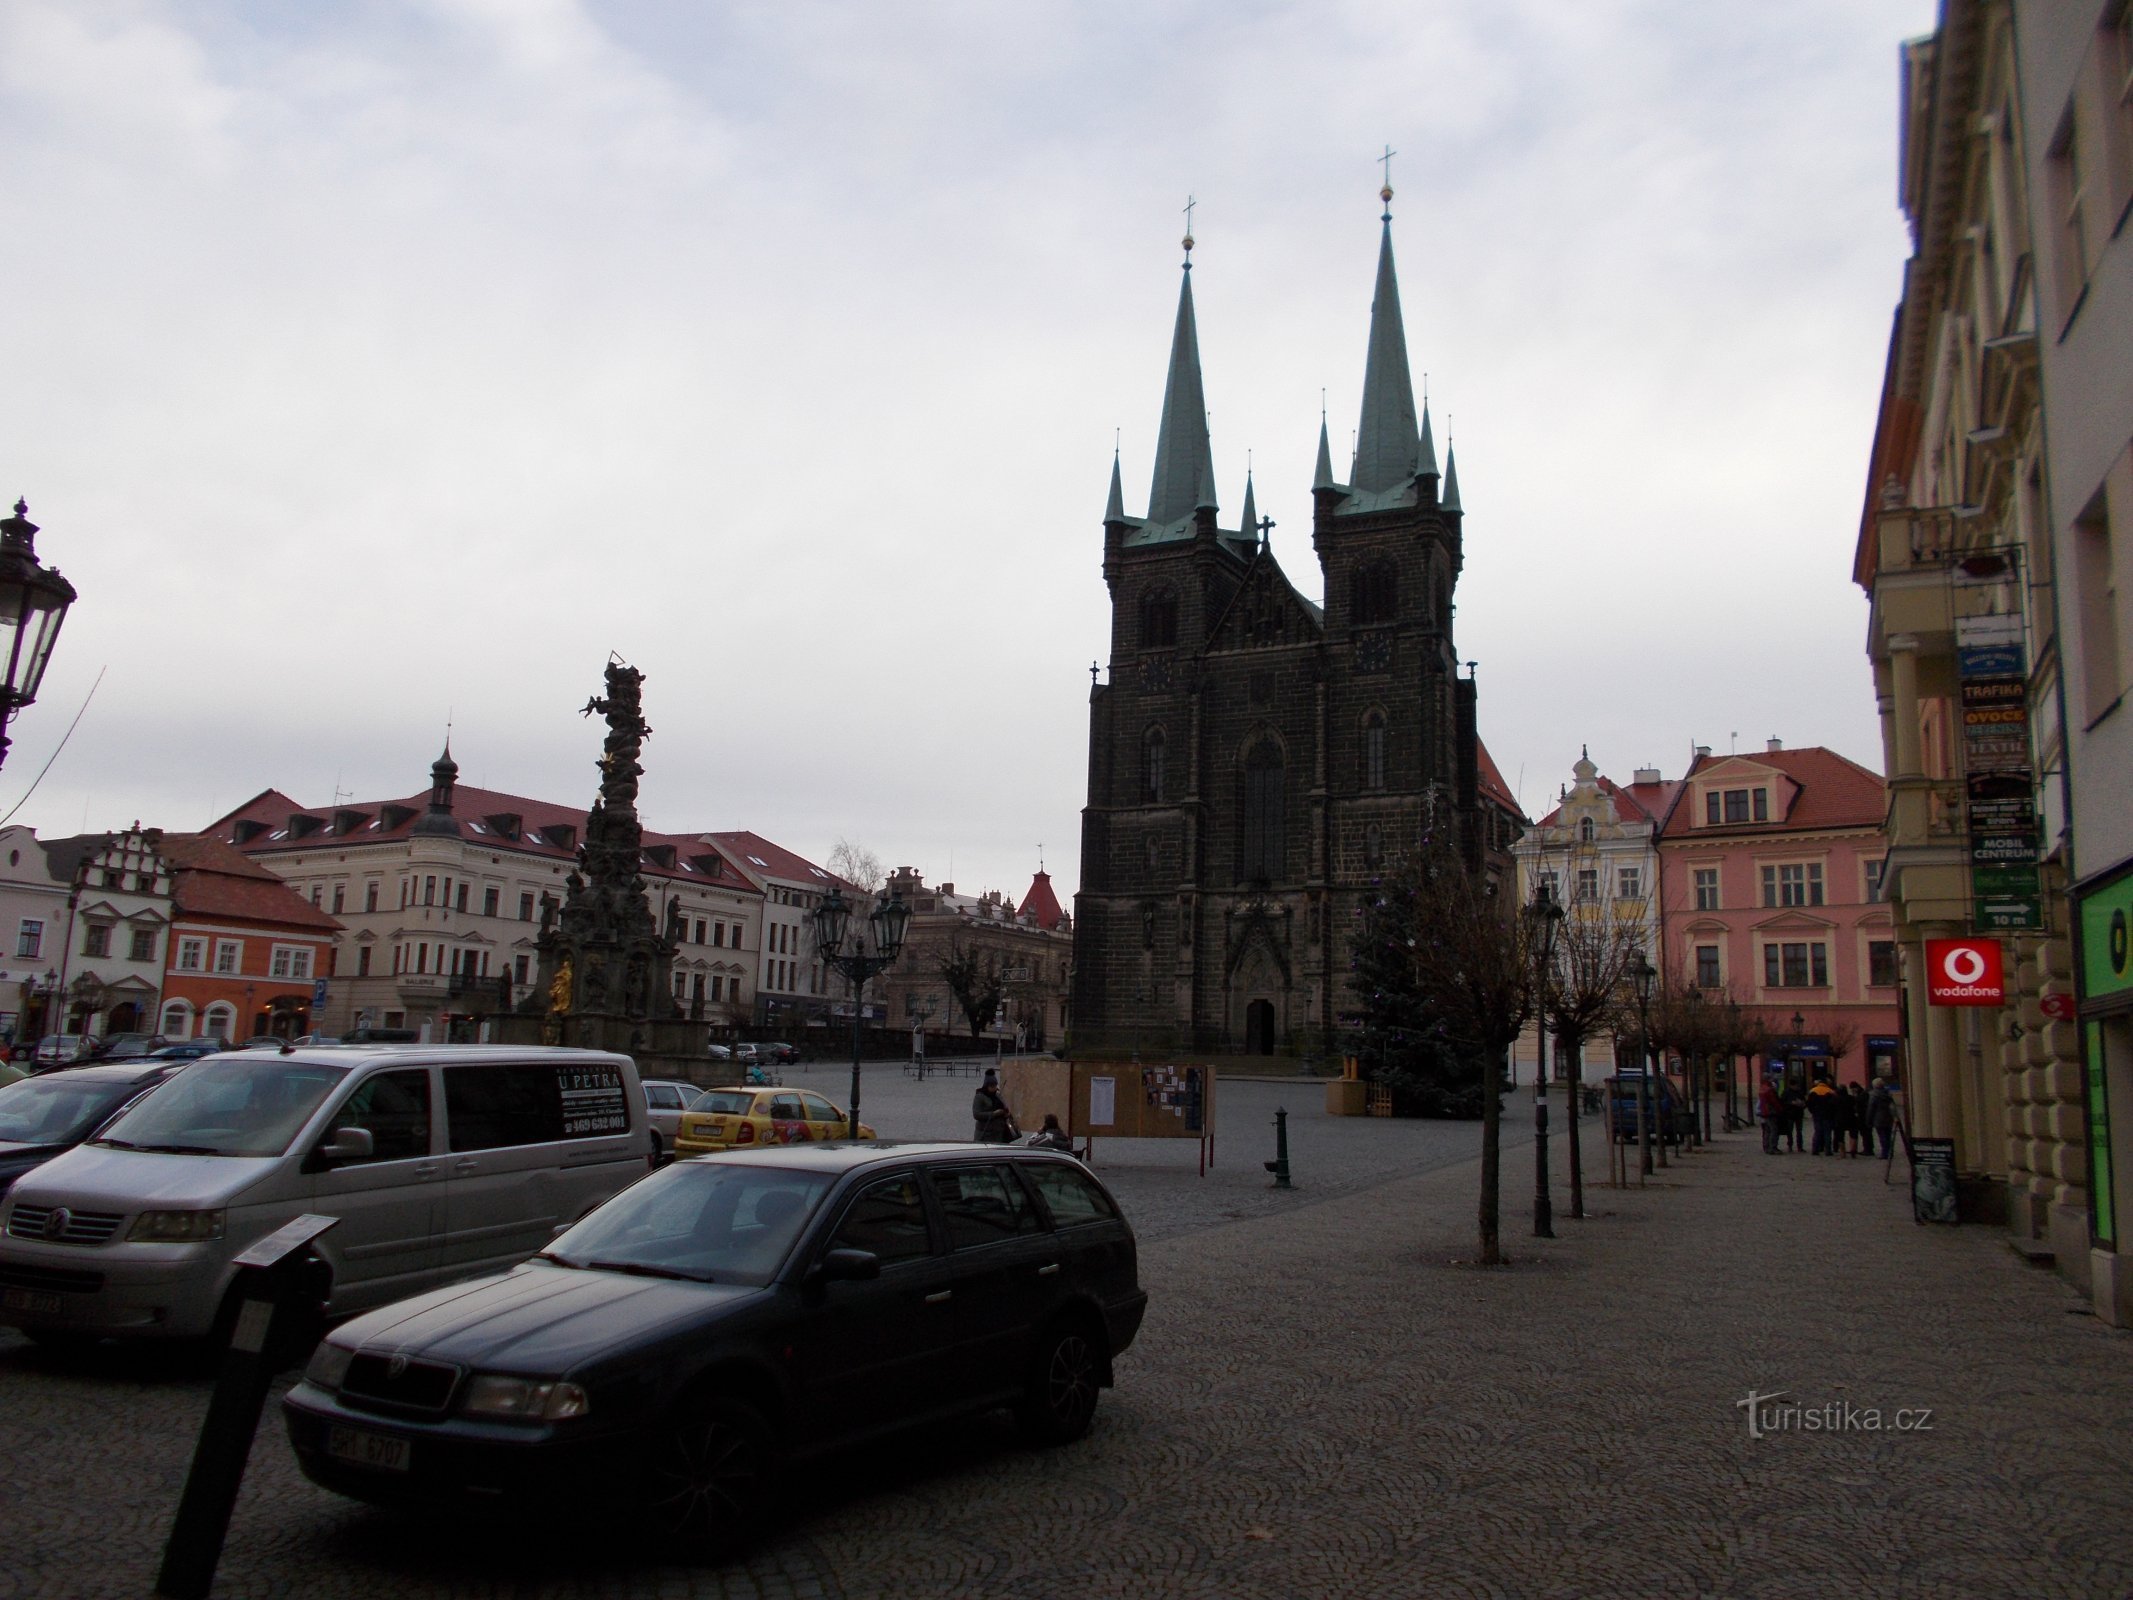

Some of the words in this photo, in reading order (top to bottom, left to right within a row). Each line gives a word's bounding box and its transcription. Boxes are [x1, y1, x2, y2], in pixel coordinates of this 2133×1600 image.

[1964, 684, 2023, 698] TRAFIKA
[1966, 710, 2025, 724] OVOCE
[1968, 742, 2025, 754] TEXTIL
[1984, 838, 2025, 848] MOBIL
[1974, 849, 2035, 860] CENTRUM
[1992, 915, 2009, 926] 10
[2012, 917, 2027, 926] m
[1933, 985, 2000, 997] vodafone
[558, 1075, 568, 1089] U
[573, 1073, 620, 1088] PETRA
[573, 1118, 591, 1132] 469
[591, 1117, 609, 1130] 632
[609, 1116, 625, 1128] 001
[367, 1437, 404, 1466] 6707
